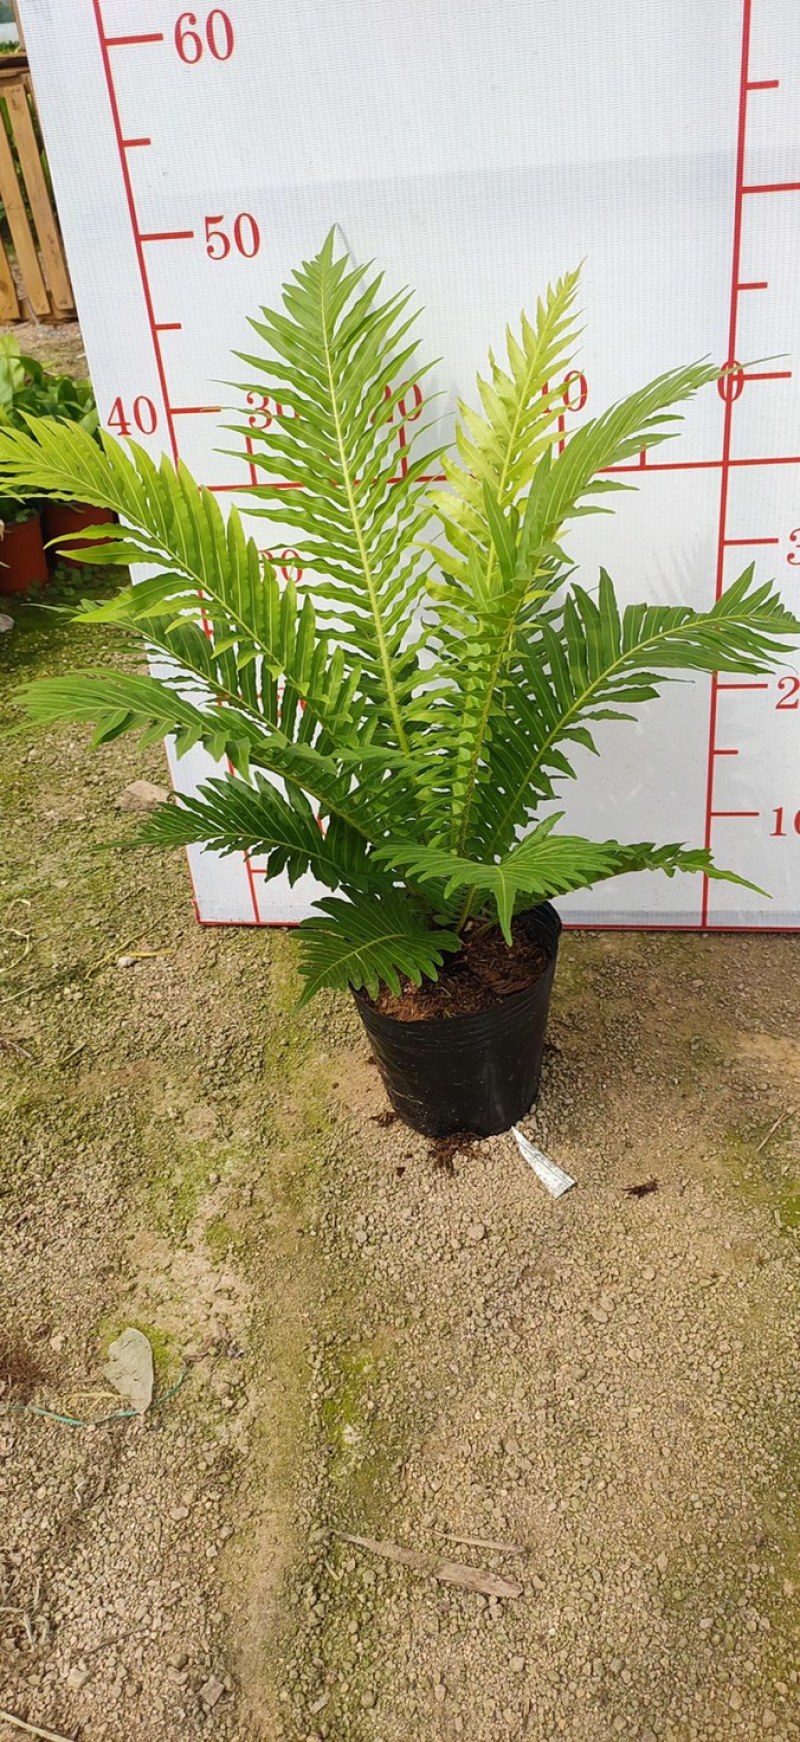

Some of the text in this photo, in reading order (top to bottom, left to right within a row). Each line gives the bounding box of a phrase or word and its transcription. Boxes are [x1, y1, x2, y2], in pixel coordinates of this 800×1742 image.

[174, 9, 235, 64] 60
[204, 212, 260, 260] 50
[107, 395, 157, 436] 40
